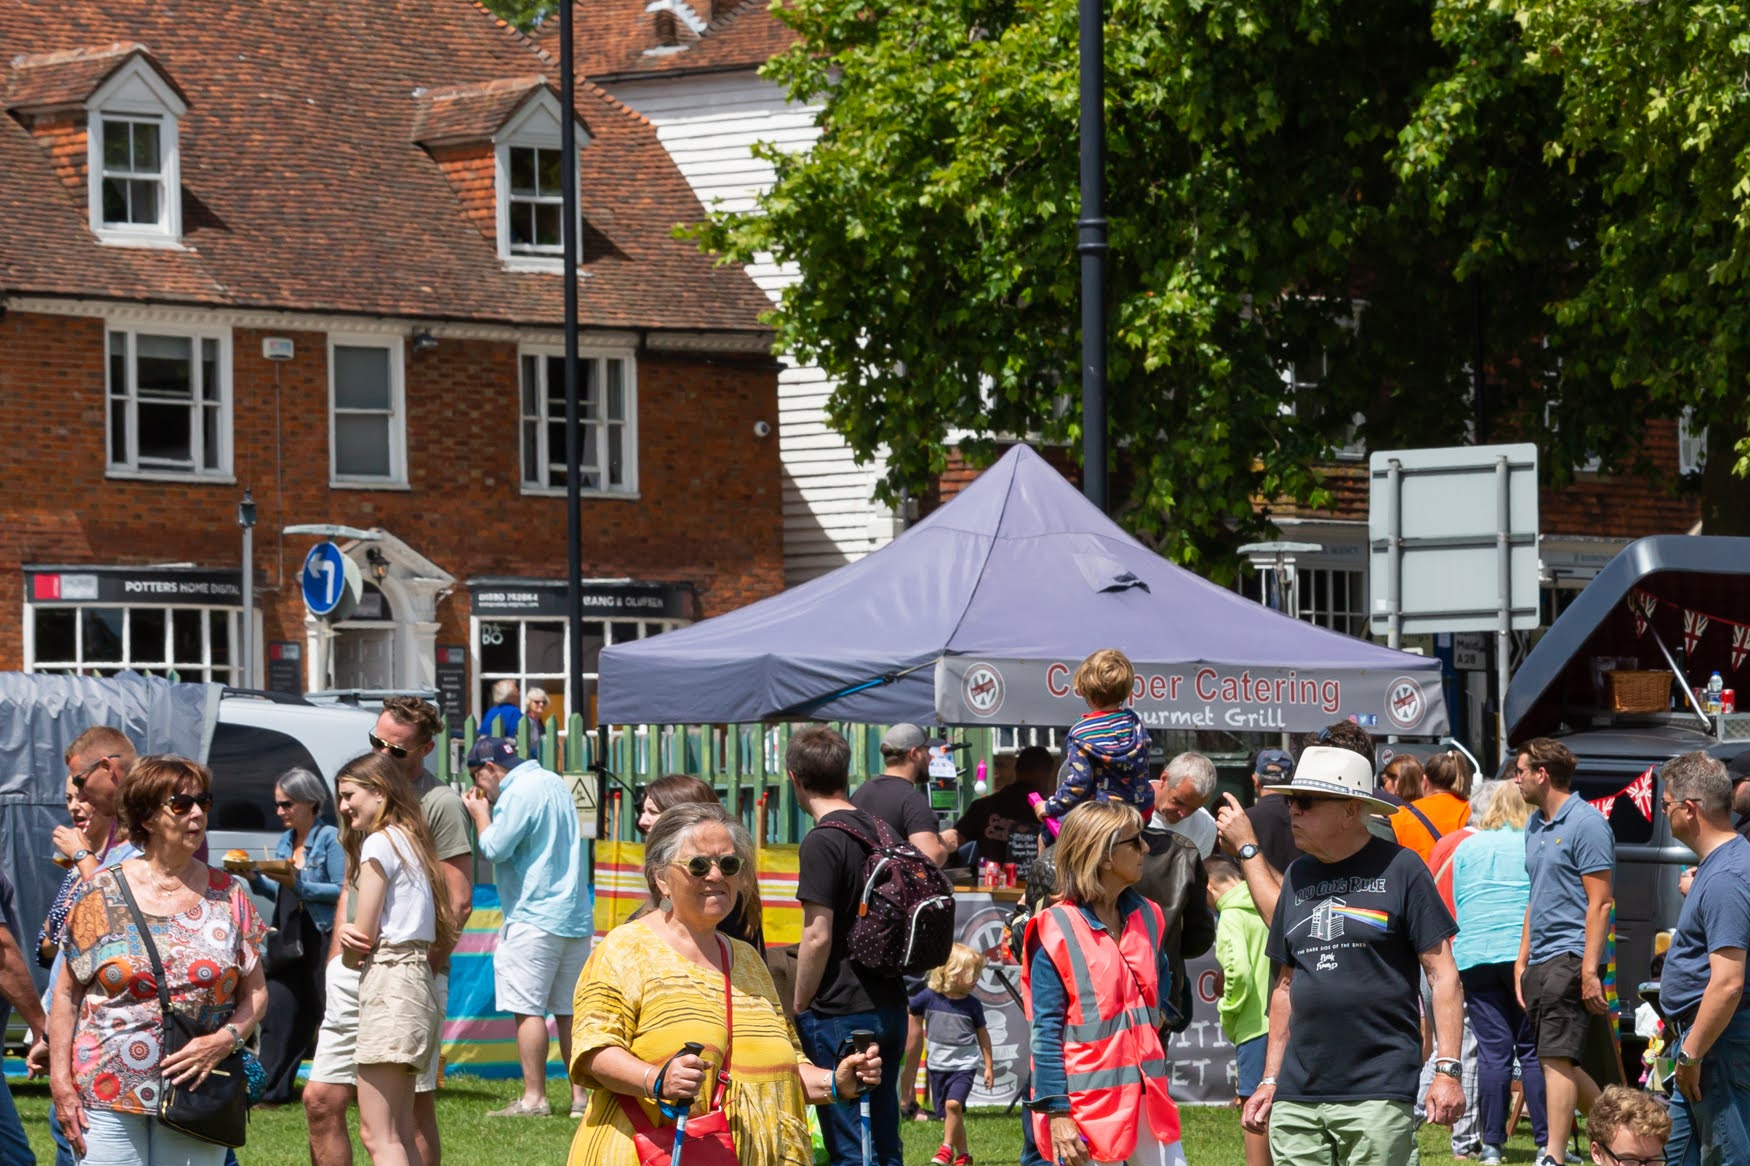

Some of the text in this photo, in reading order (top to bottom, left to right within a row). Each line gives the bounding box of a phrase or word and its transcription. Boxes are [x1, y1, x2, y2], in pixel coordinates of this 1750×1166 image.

[125, 580, 177, 593] POTTERS
[179, 581, 209, 594] HOME
[1046, 662, 1341, 715] Cper Catering
[1136, 705, 1286, 728] urmet Grill
[1295, 885, 1316, 906] OLD
[1349, 876, 1387, 893] RULE
